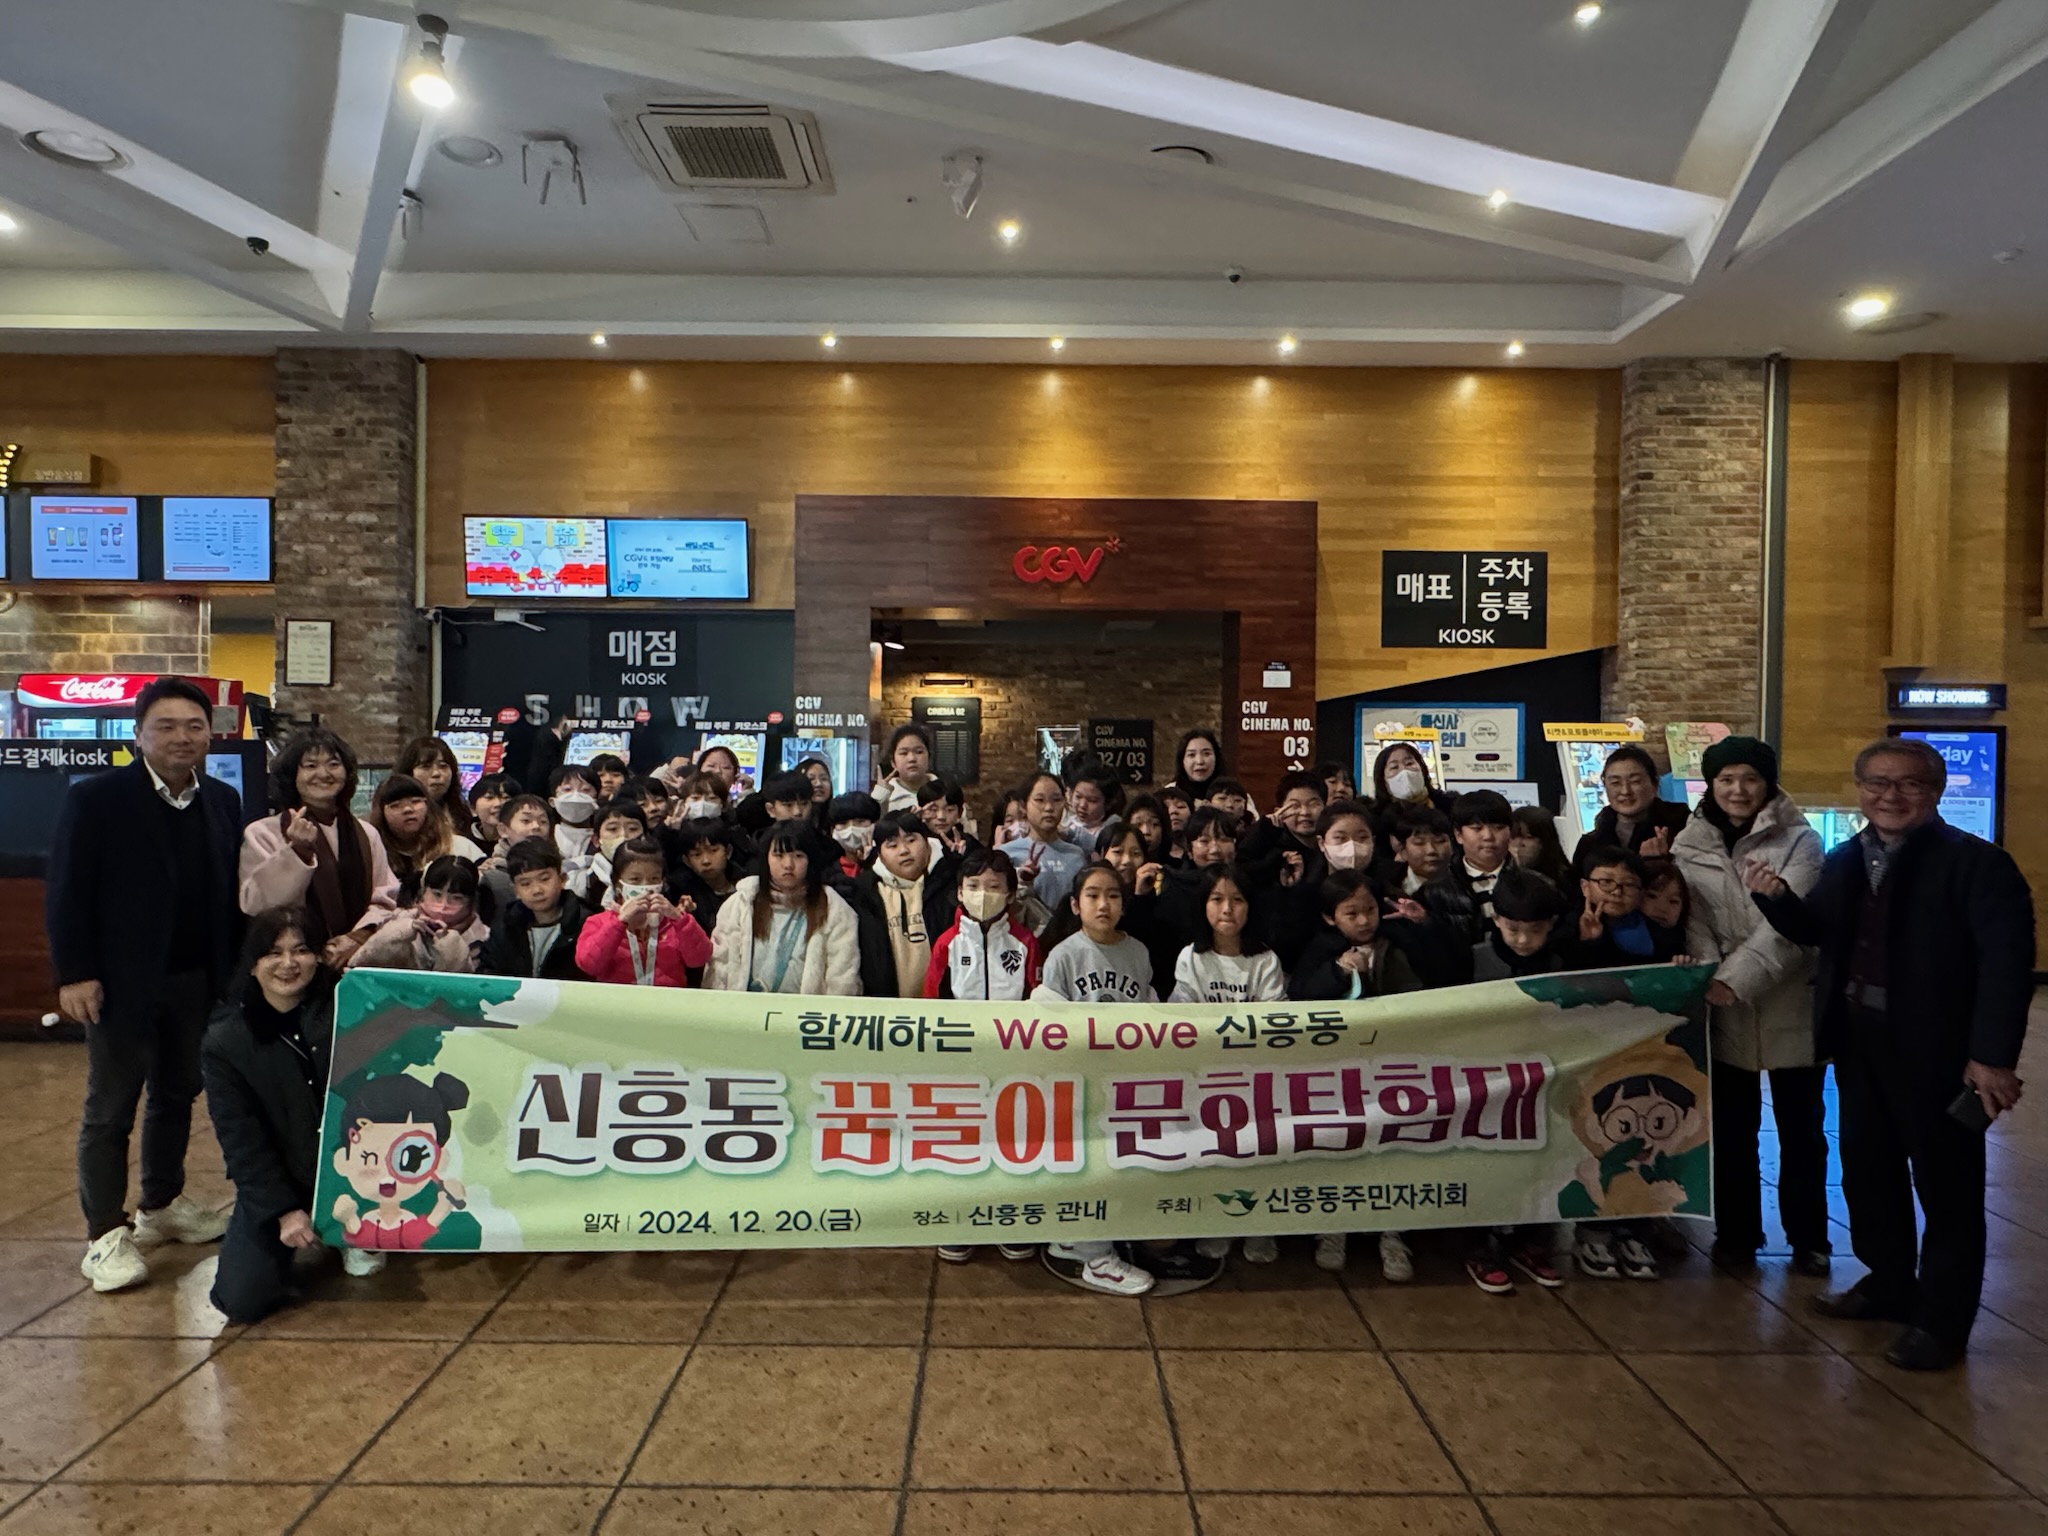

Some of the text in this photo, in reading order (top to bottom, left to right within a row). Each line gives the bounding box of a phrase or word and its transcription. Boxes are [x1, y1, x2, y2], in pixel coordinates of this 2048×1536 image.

[692, 564, 712, 573] eats
[1013, 546, 1104, 583] CGV
[1477, 557, 1534, 587] 주차
[1396, 573, 1453, 603] 매표
[1477, 591, 1532, 622] 등록
[1438, 628, 1495, 644] KIOSK
[608, 630, 677, 666] 매점
[621, 672, 667, 686] KIOSK
[795, 696, 822, 710] CGV
[1908, 690, 1989, 703] NOW SHOWING
[927, 707, 954, 716] CINEMA
[1241, 701, 1268, 714] CGV
[448, 717, 493, 727] 키오스크
[601, 720, 635, 729] 키오스크
[734, 722, 768, 731] 키오스크
[795, 713, 843, 726] CINEMA
[847, 714, 868, 727] NO.
[1241, 718, 1313, 731] CINEMA NO.
[1095, 725, 1115, 736] CGV
[1095, 738, 1130, 749] CINEMA
[1283, 737, 1310, 757] 03
[0, 747, 108, 769] 드결제kiosk
[1127, 752, 1146, 767] 03
[1074, 970, 1141, 999] PARIS
[798, 1012, 975, 1052] 함께하는
[993, 1018, 1069, 1050] We
[1088, 1017, 1198, 1050] Love
[1215, 1011, 1348, 1049] 신흥동
[517, 1071, 784, 1165] 신흥동
[1108, 1062, 1546, 1161] 문화탐험대
[1156, 1183, 1467, 1214] 주최 신흥동주민자치회
[913, 1199, 1107, 1226] 장소 신흥동 관내
[583, 1213, 620, 1233] 일자
[638, 1210, 717, 1234] 2024.
[729, 1210, 766, 1233] 12.
